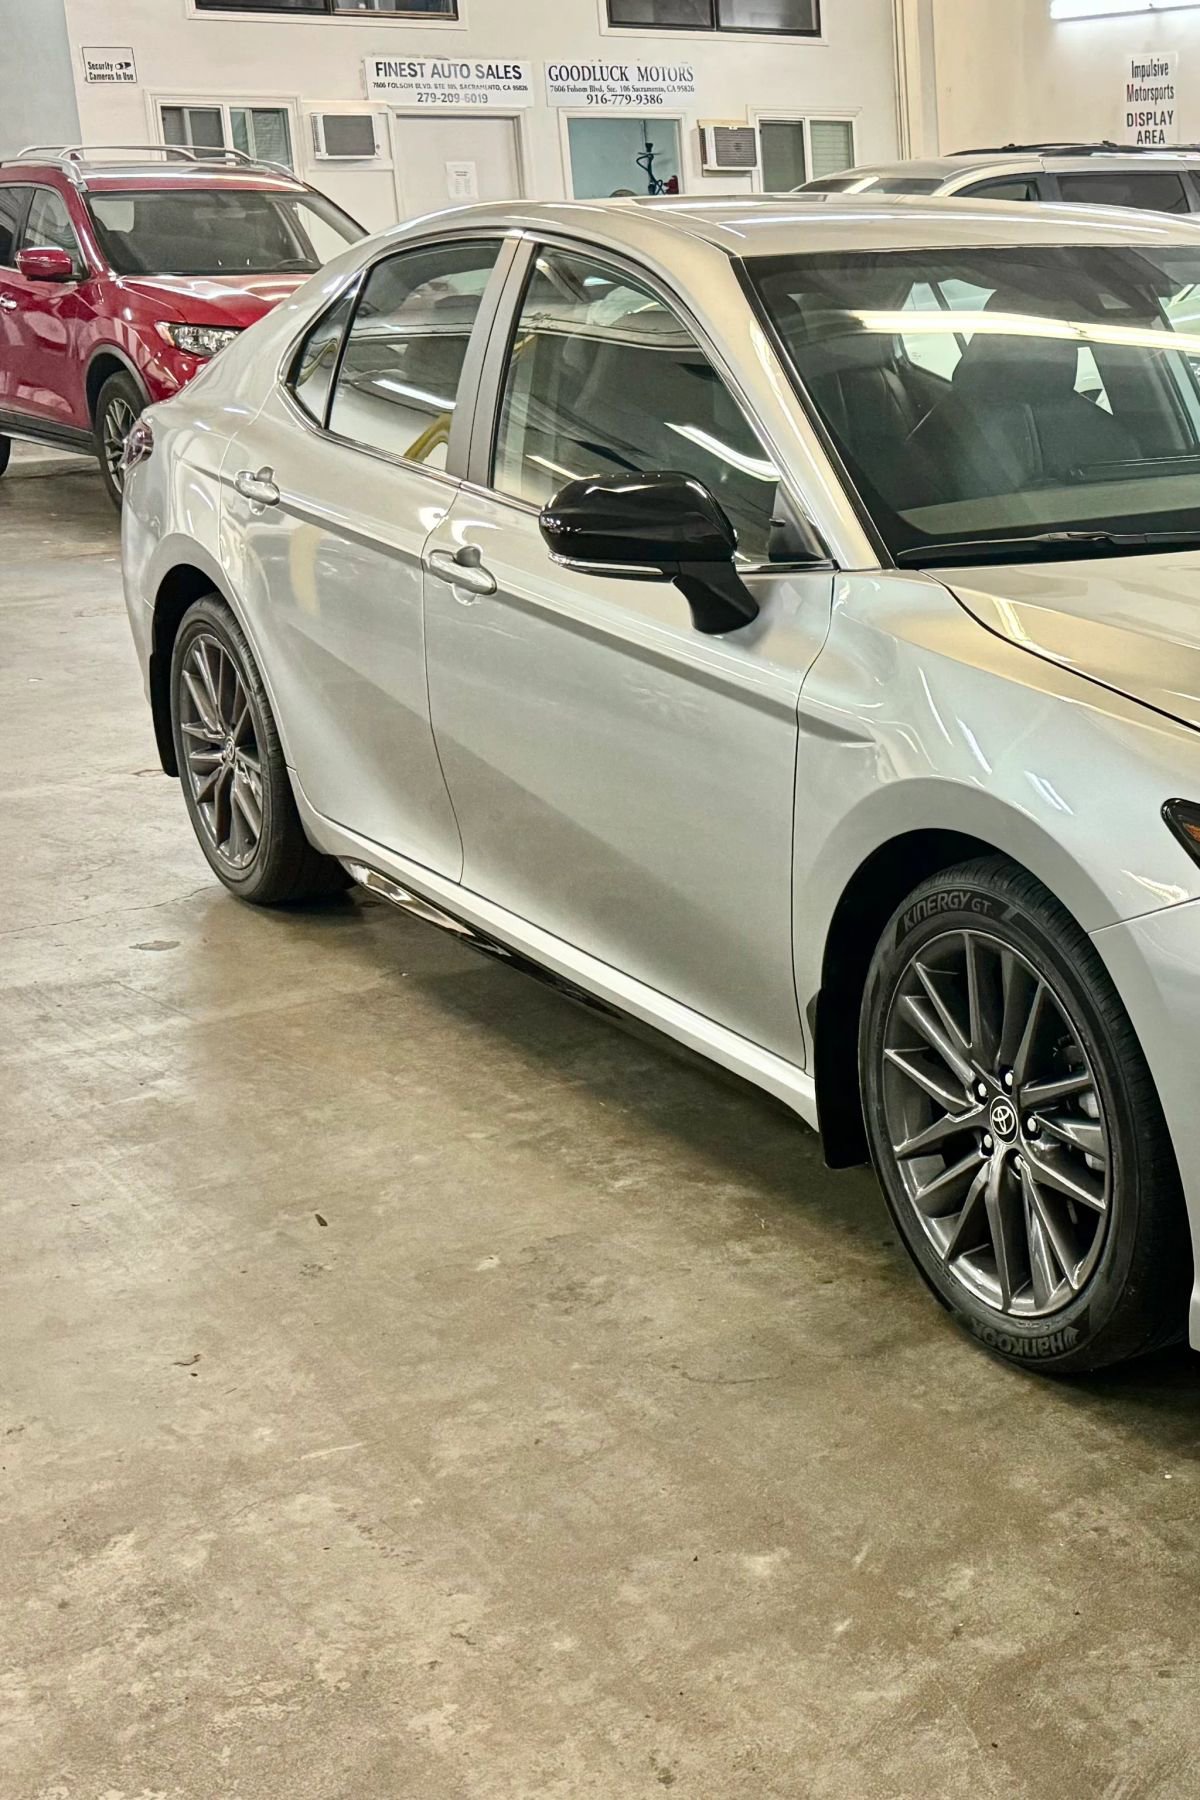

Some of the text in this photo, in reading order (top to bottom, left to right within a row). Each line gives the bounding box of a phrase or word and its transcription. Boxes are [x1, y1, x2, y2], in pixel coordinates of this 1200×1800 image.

[87, 61, 114, 72] Security
[375, 61, 522, 80] FINEST AUTO SALES
[548, 65, 694, 82] GOODLUCK MOTORS
[1131, 58, 1169, 82] Impulsive
[89, 71, 115, 80] Cameras
[122, 71, 134, 80] Use
[666, 84, 677, 93] CA
[1126, 83, 1175, 106] Motorsports
[417, 92, 489, 104] 279-209-6019
[586, 93, 663, 105] 916-779-9386
[1126, 110, 1174, 127] DISPLAY
[1136, 129, 1166, 144] AREA
[903, 891, 992, 932] KINERGY GT
